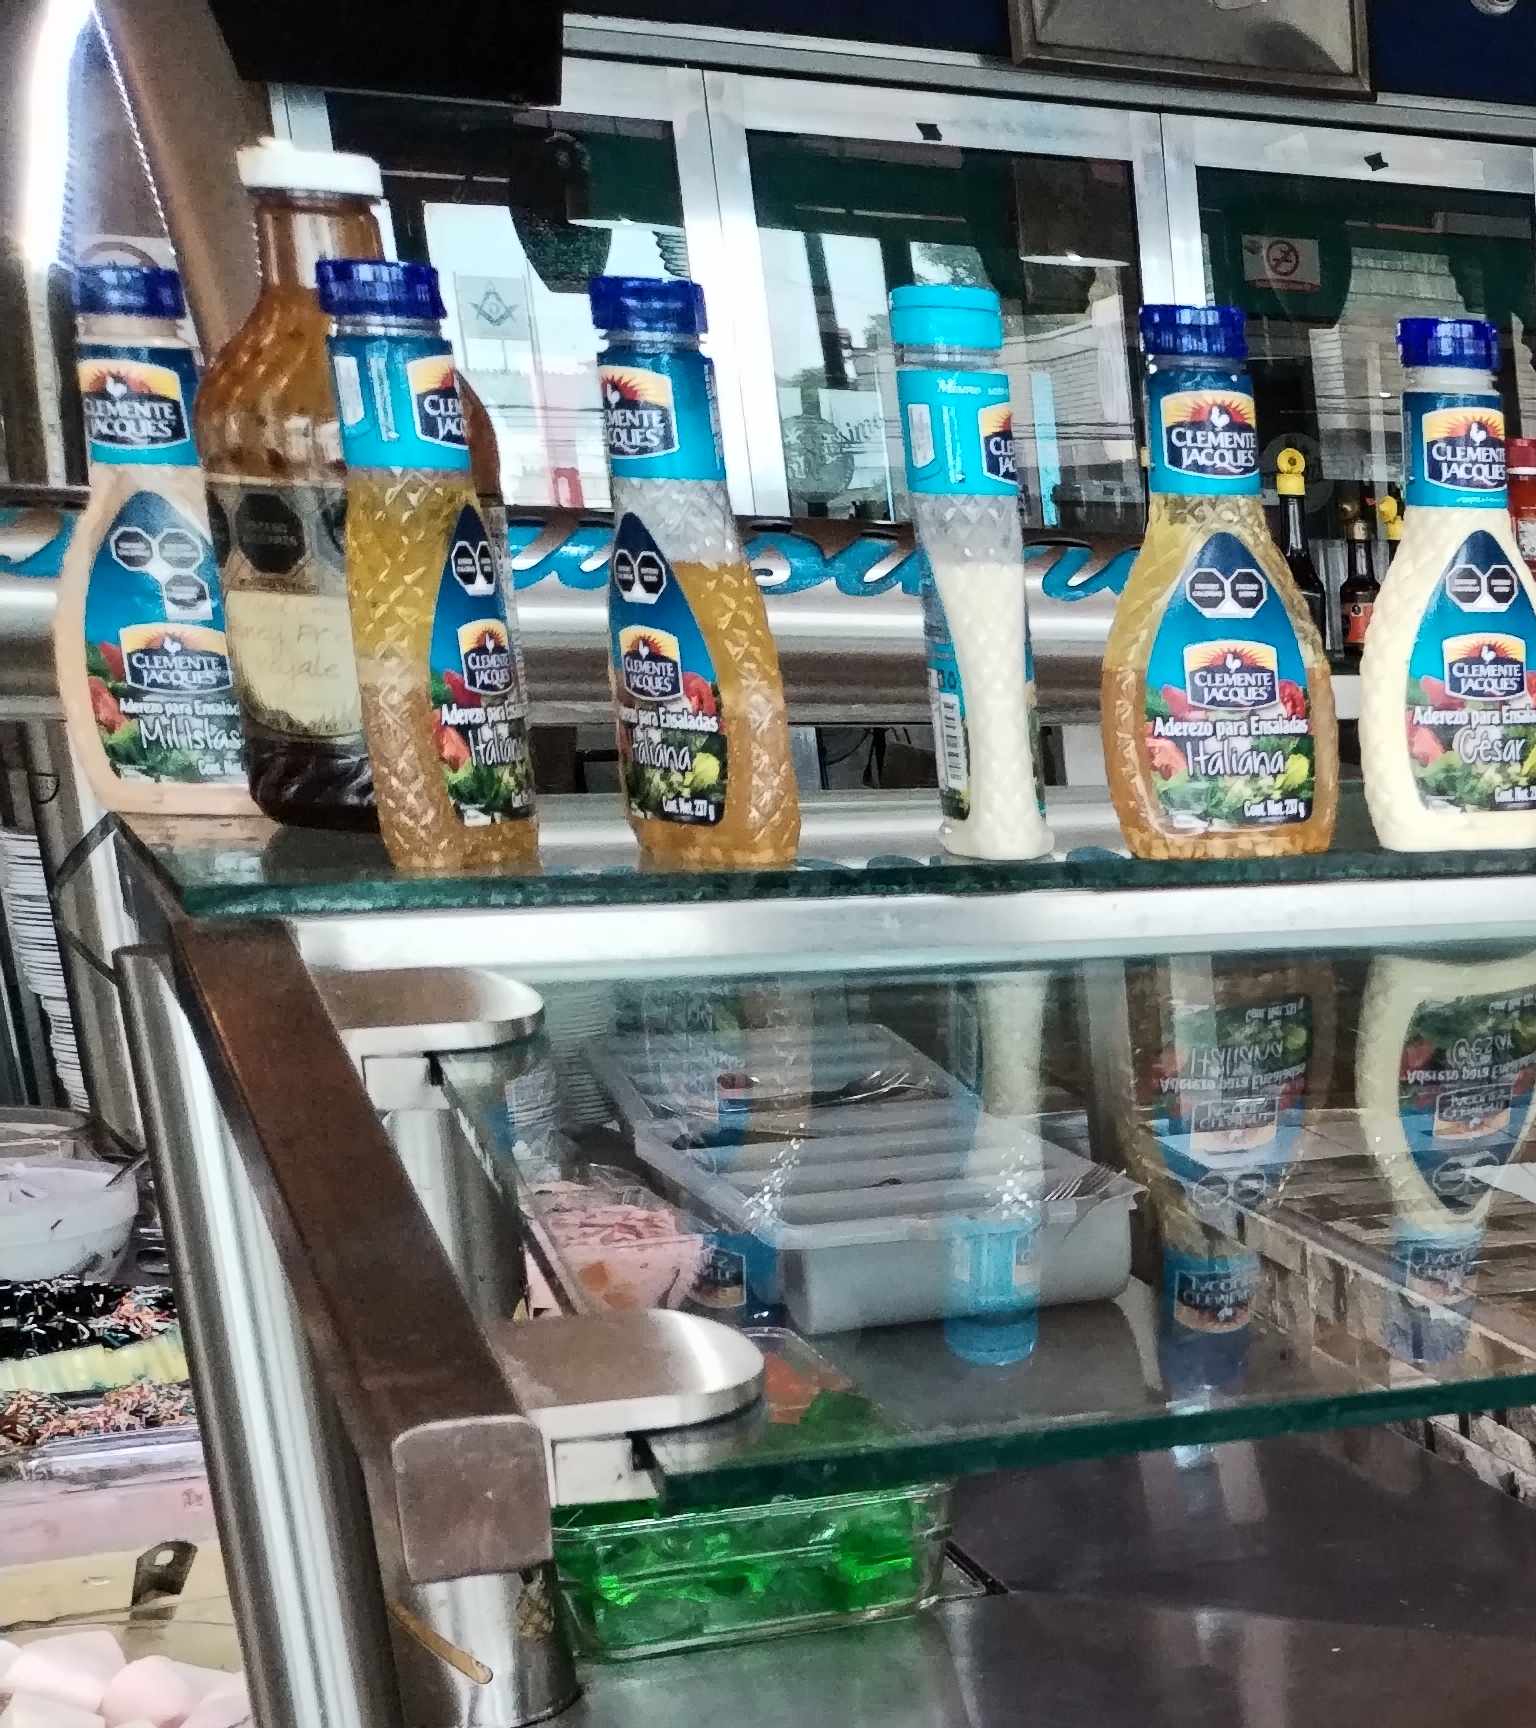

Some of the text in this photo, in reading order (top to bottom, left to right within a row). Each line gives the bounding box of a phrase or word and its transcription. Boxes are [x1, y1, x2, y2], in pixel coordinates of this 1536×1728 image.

[1171, 427, 1257, 449] CLEMENTE
[1181, 447, 1255, 474] JACQUES
[131, 652, 222, 672] CLEMENTE
[1452, 663, 1522, 678] CLEMENTE
[142, 669, 218, 691] JACQUES
[1194, 671, 1273, 687] CLEMENTE
[1461, 677, 1519, 696] JACQUES
[1203, 686, 1269, 706] JACQUES
[659, 706, 719, 733] Ensaladas
[1153, 715, 1309, 741] Aderezo para Ensaladas
[1413, 705, 1470, 725] Aderezo
[1471, 710, 1501, 729] para
[1186, 738, 1285, 776] Italiana
[1460, 728, 1526, 764] César
